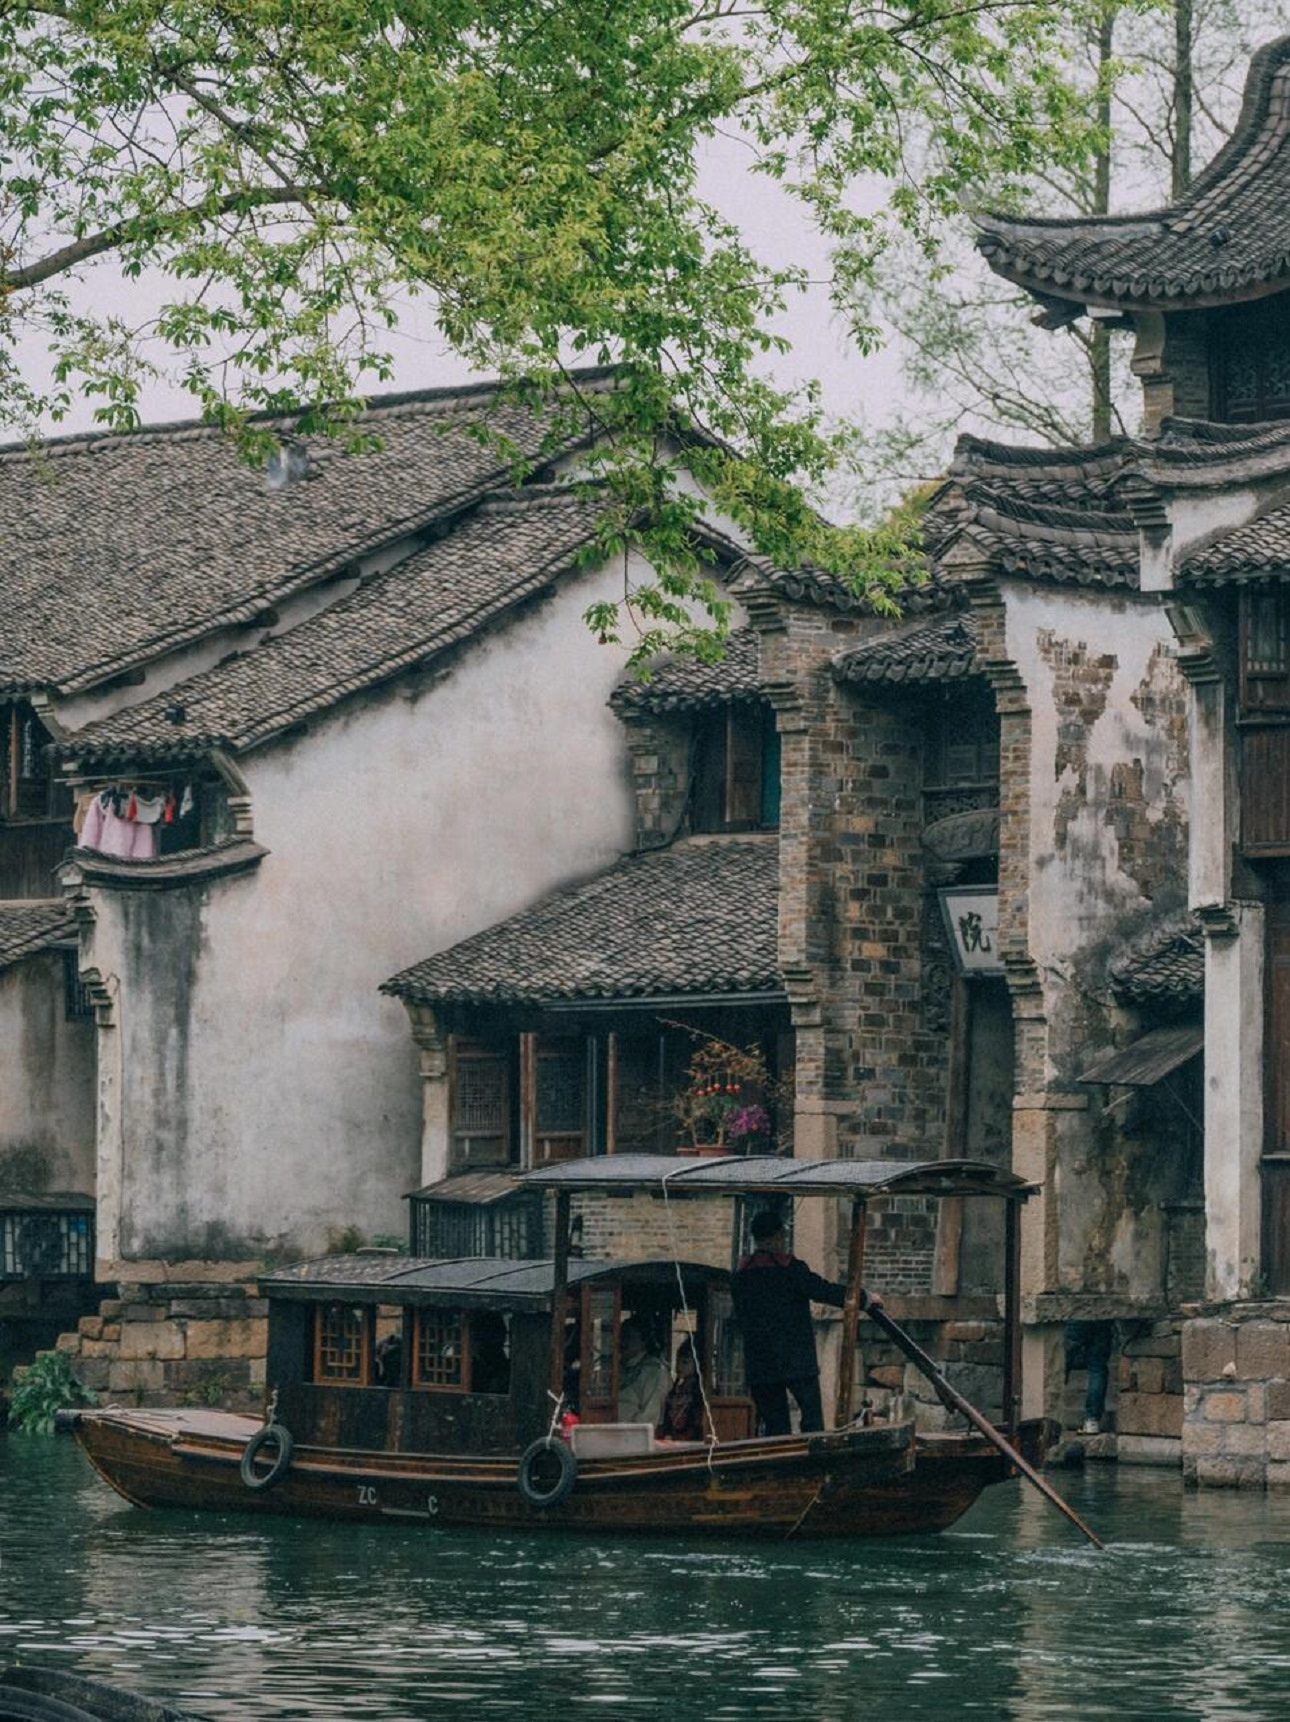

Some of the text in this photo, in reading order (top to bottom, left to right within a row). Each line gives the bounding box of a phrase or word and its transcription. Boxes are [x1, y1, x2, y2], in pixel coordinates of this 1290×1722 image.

[958, 911, 991, 952] 院
[357, 1485, 439, 1515] ZC C
